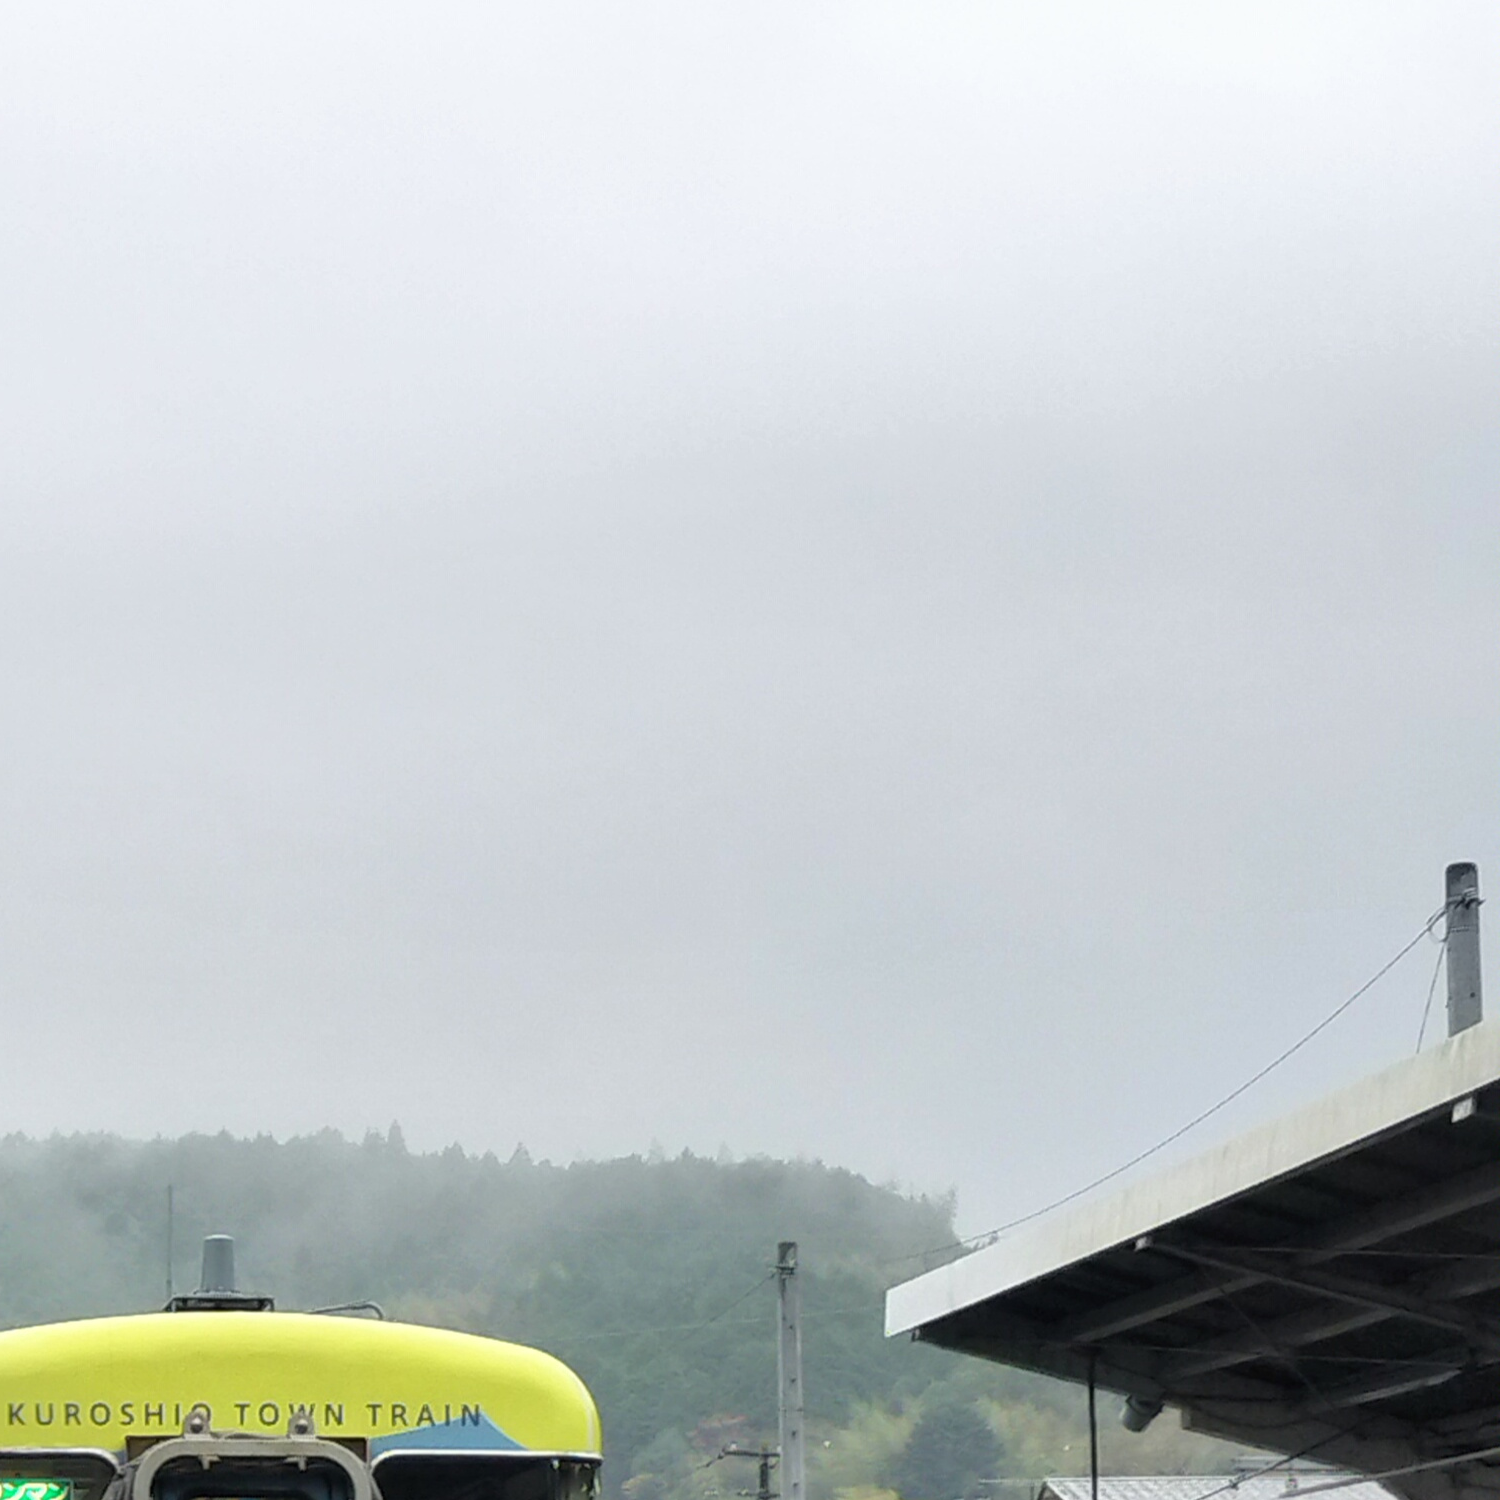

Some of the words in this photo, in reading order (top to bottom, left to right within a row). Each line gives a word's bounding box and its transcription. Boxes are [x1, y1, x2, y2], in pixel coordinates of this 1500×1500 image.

[7, 1402, 212, 1426] KUROSHIO
[234, 1403, 345, 1426] TOWN
[366, 1403, 481, 1427] TRAIN
